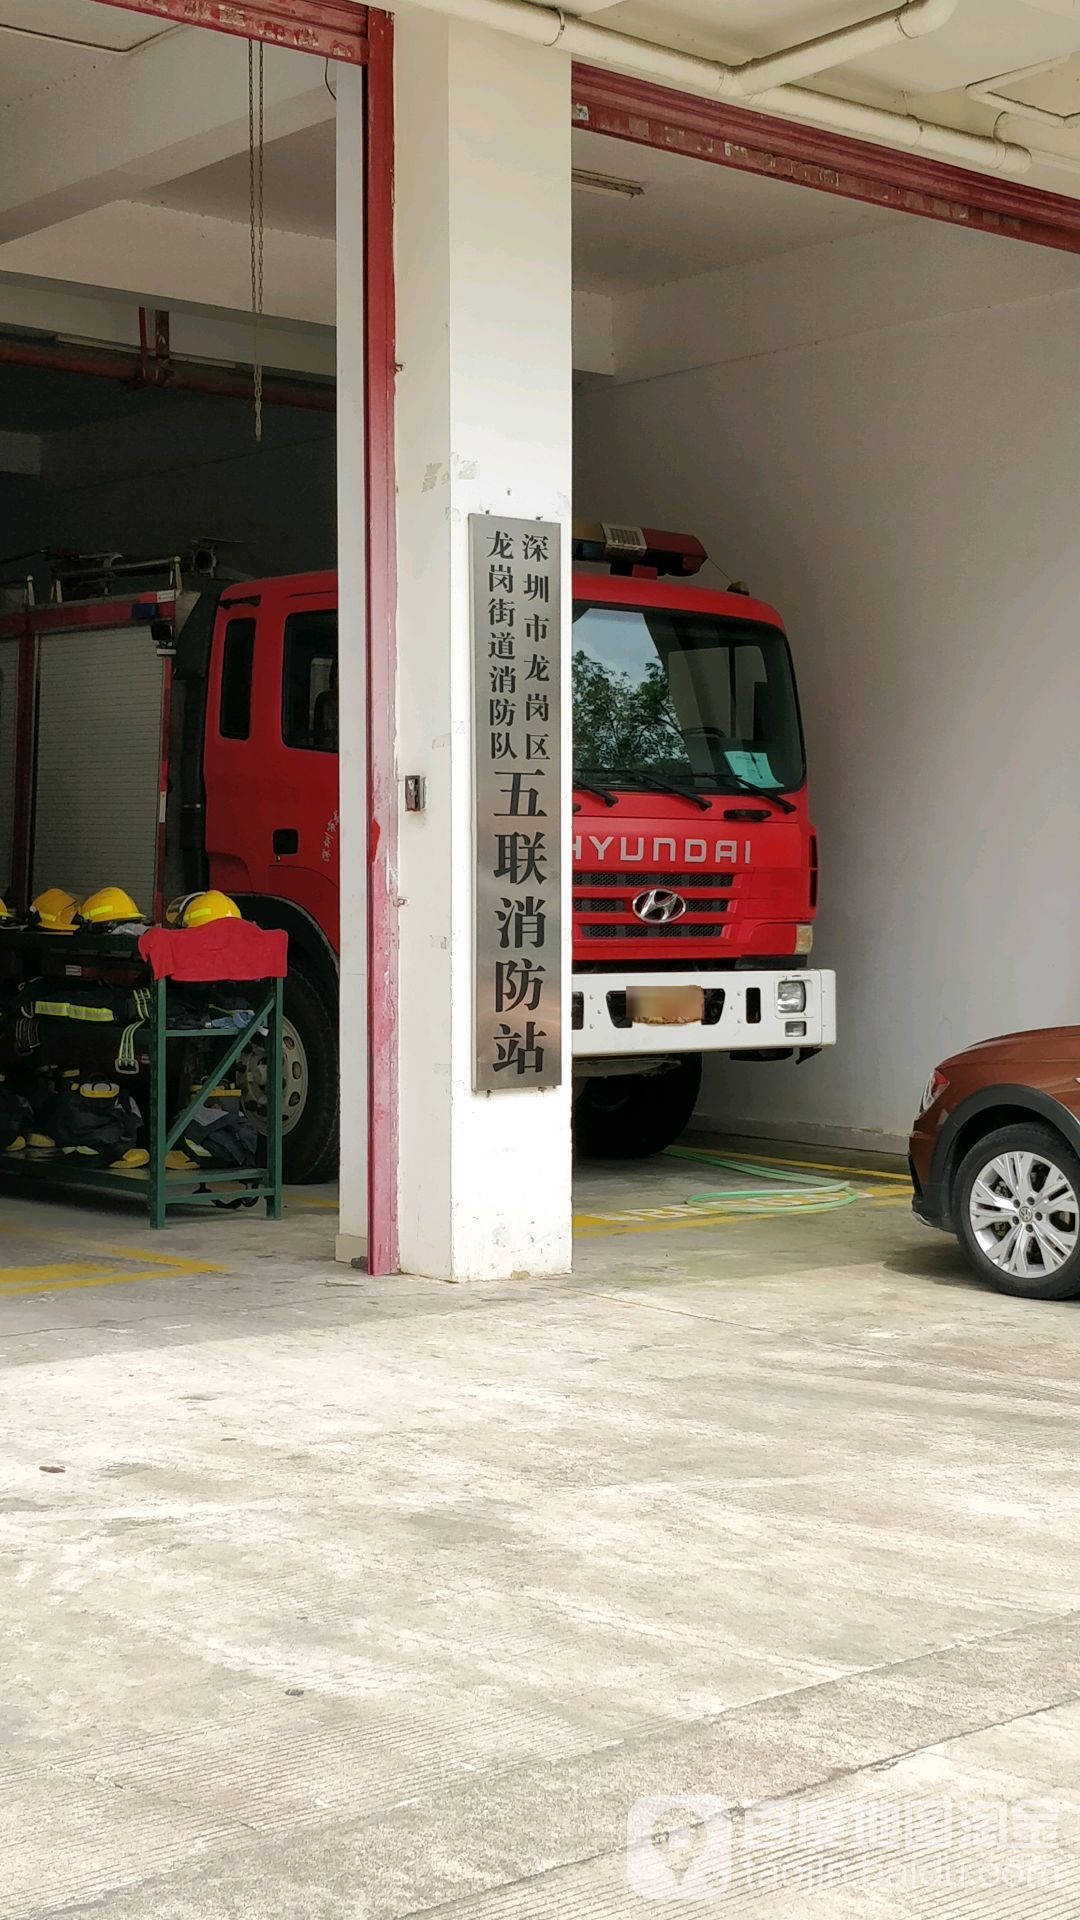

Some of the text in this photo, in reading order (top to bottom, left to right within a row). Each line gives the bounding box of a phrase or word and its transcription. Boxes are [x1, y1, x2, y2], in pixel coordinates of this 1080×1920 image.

[486, 530, 518, 761] 龙岗街道消防队
[521, 532, 551, 761] 深圳市龙岗区
[493, 768, 548, 1076] 五联消防站
